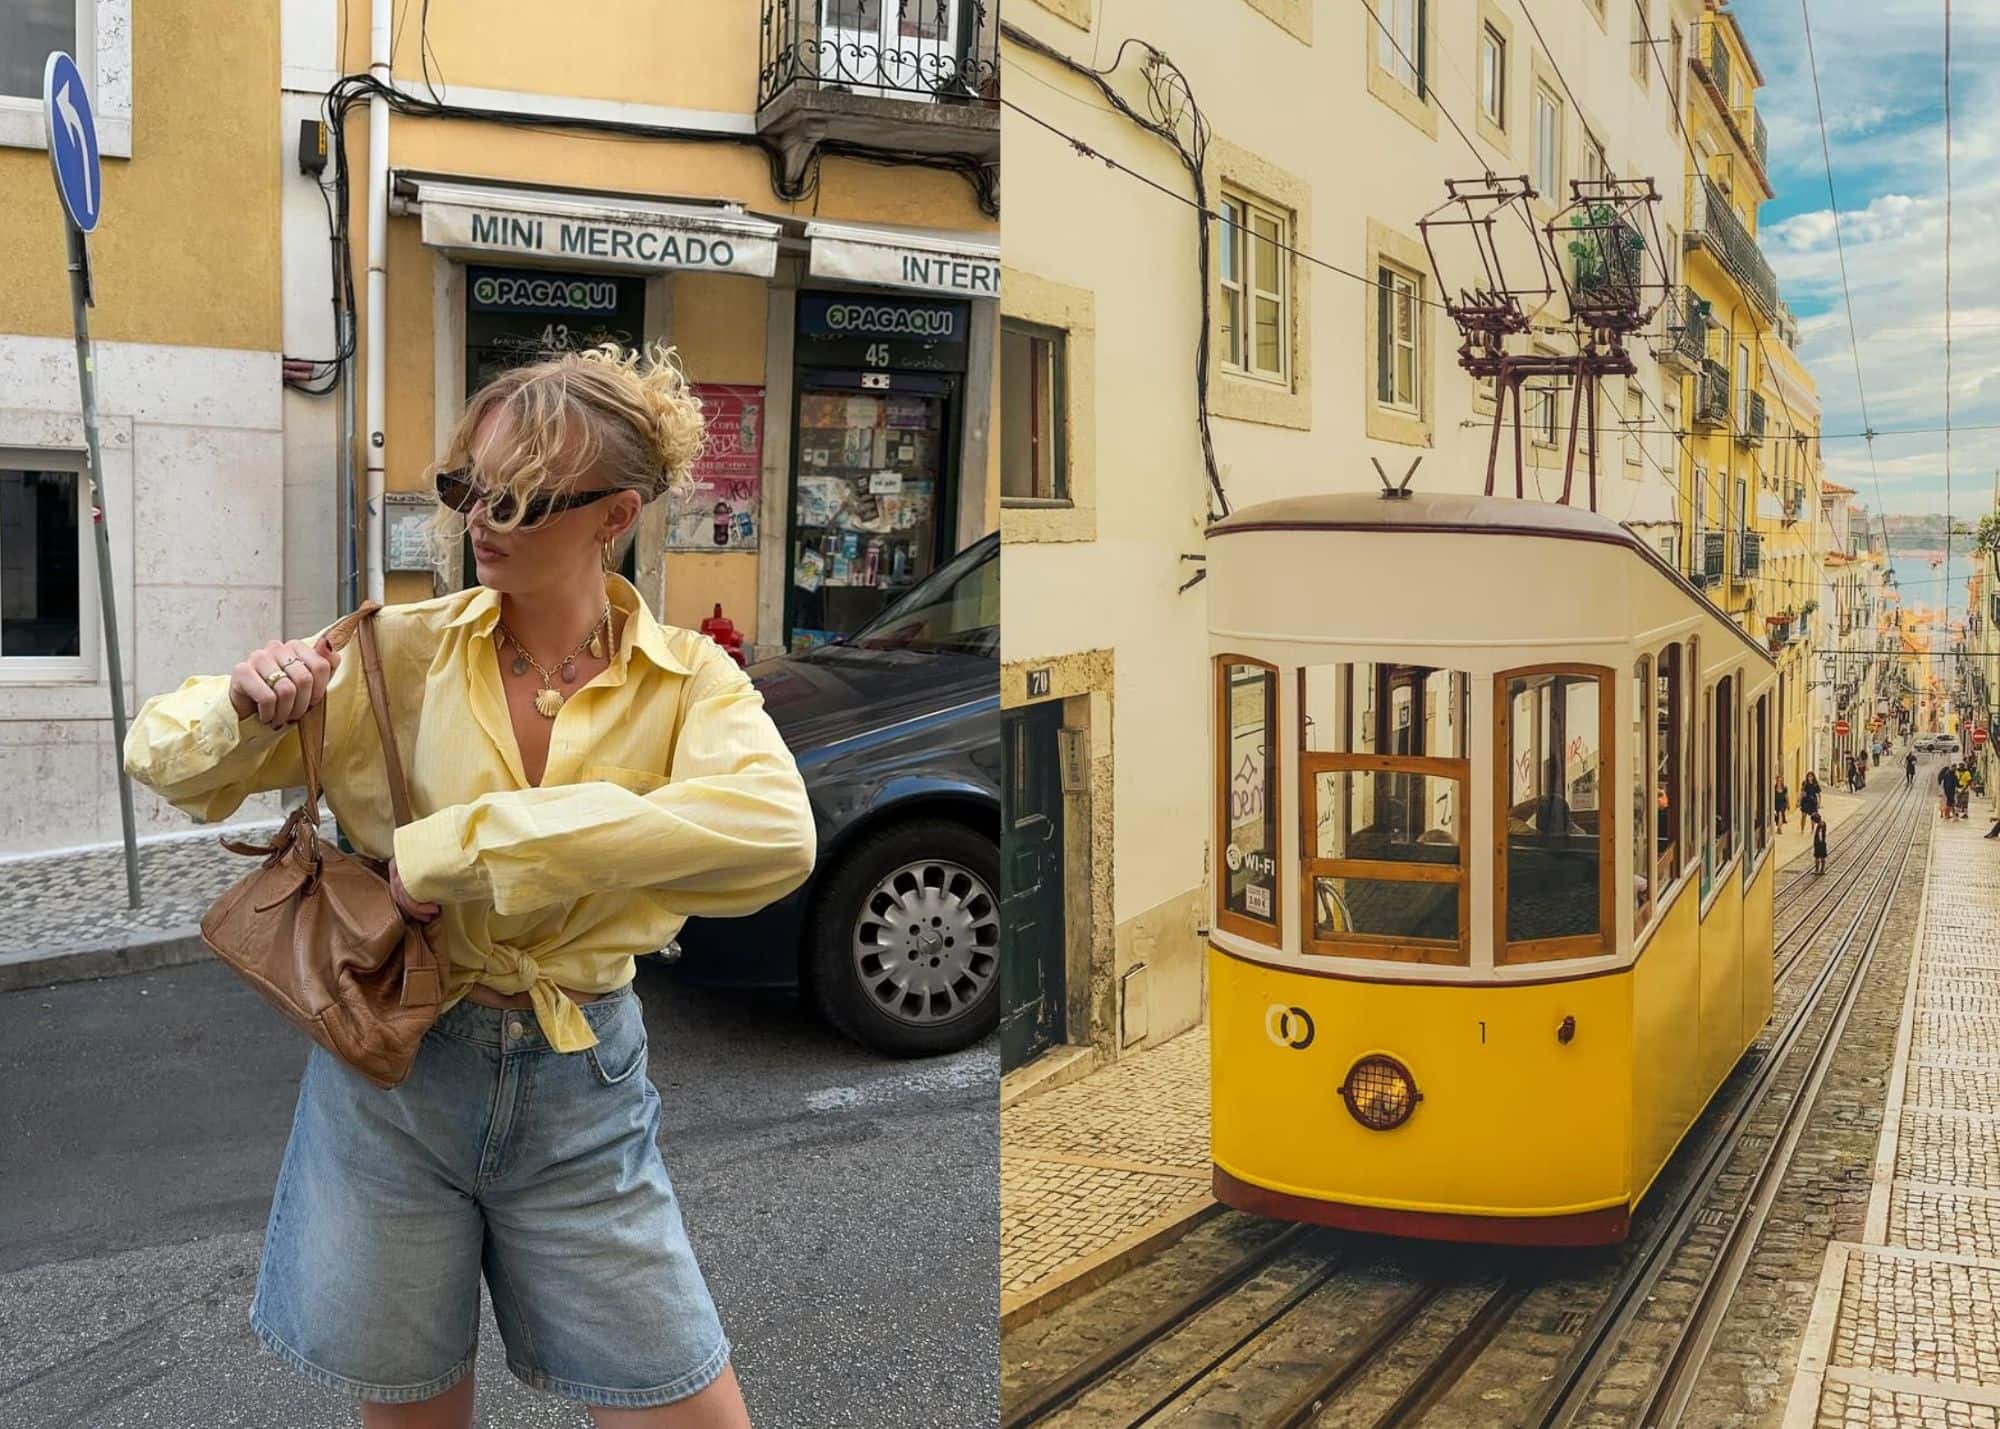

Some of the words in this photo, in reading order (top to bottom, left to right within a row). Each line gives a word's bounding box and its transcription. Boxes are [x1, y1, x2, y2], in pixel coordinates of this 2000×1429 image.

[472, 214, 543, 249] MINI
[560, 224, 734, 266] MERCADO
[541, 324, 568, 349] 43
[865, 343, 889, 367] 45
[1032, 671, 1048, 694] 70
[1244, 852, 1275, 876] WI-FI
[1478, 1021, 1485, 1044] 1
